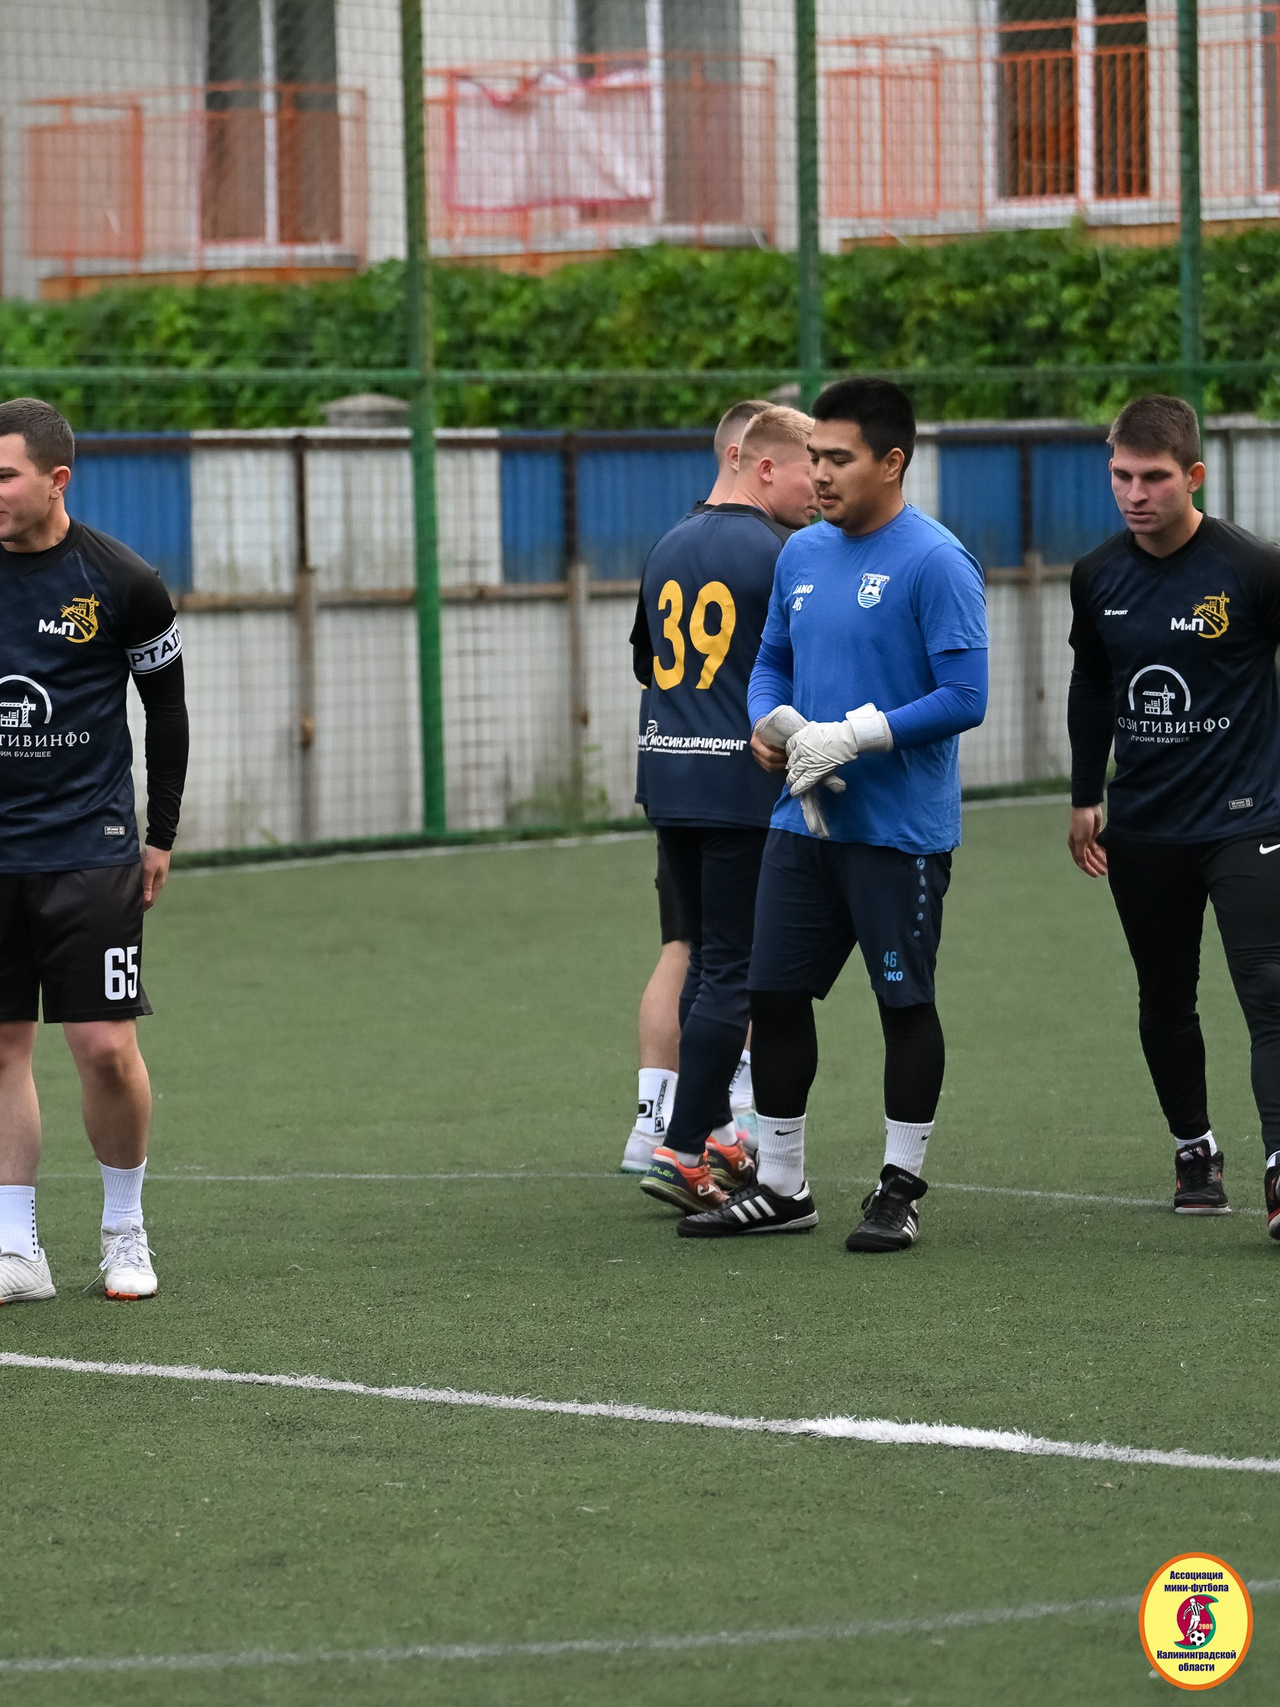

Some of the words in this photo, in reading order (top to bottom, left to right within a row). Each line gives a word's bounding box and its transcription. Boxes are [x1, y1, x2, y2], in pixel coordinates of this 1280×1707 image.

[792, 584, 814, 595] JAKO
[653, 580, 736, 690] 39
[1117, 716, 1231, 734] ОЗИТИВИНФО
[883, 950, 897, 968] 46
[104, 946, 139, 1001] 65
